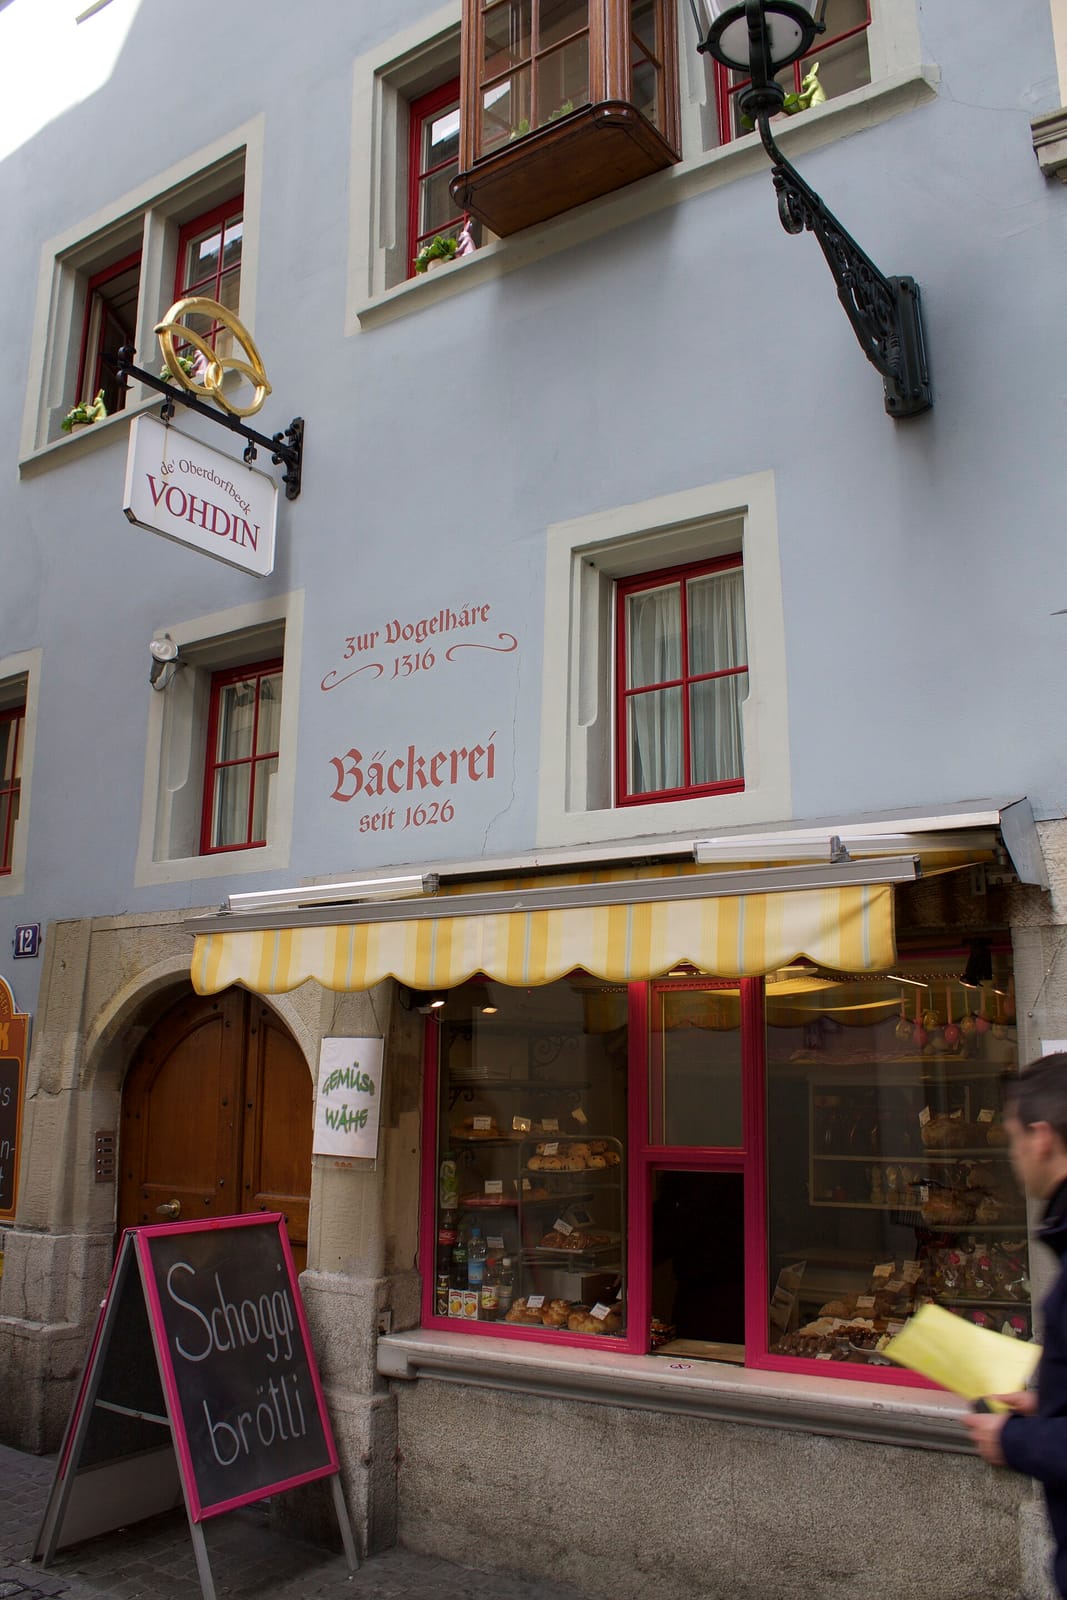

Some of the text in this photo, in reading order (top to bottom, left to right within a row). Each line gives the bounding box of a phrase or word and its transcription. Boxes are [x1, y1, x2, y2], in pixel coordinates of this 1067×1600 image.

[146, 473, 260, 552] VOHDIN
[179, 459, 252, 515] Oberdorfbeck
[343, 603, 491, 659] zur Vogelhäre
[391, 648, 435, 680] 1316
[329, 730, 497, 802] Bäckerei
[359, 799, 455, 833] seit 1626
[19, 929, 32, 952] 12
[325, 1104, 368, 1134] WÄHE
[167, 1262, 294, 1362] Schoggi
[203, 1373, 306, 1466] brötli
